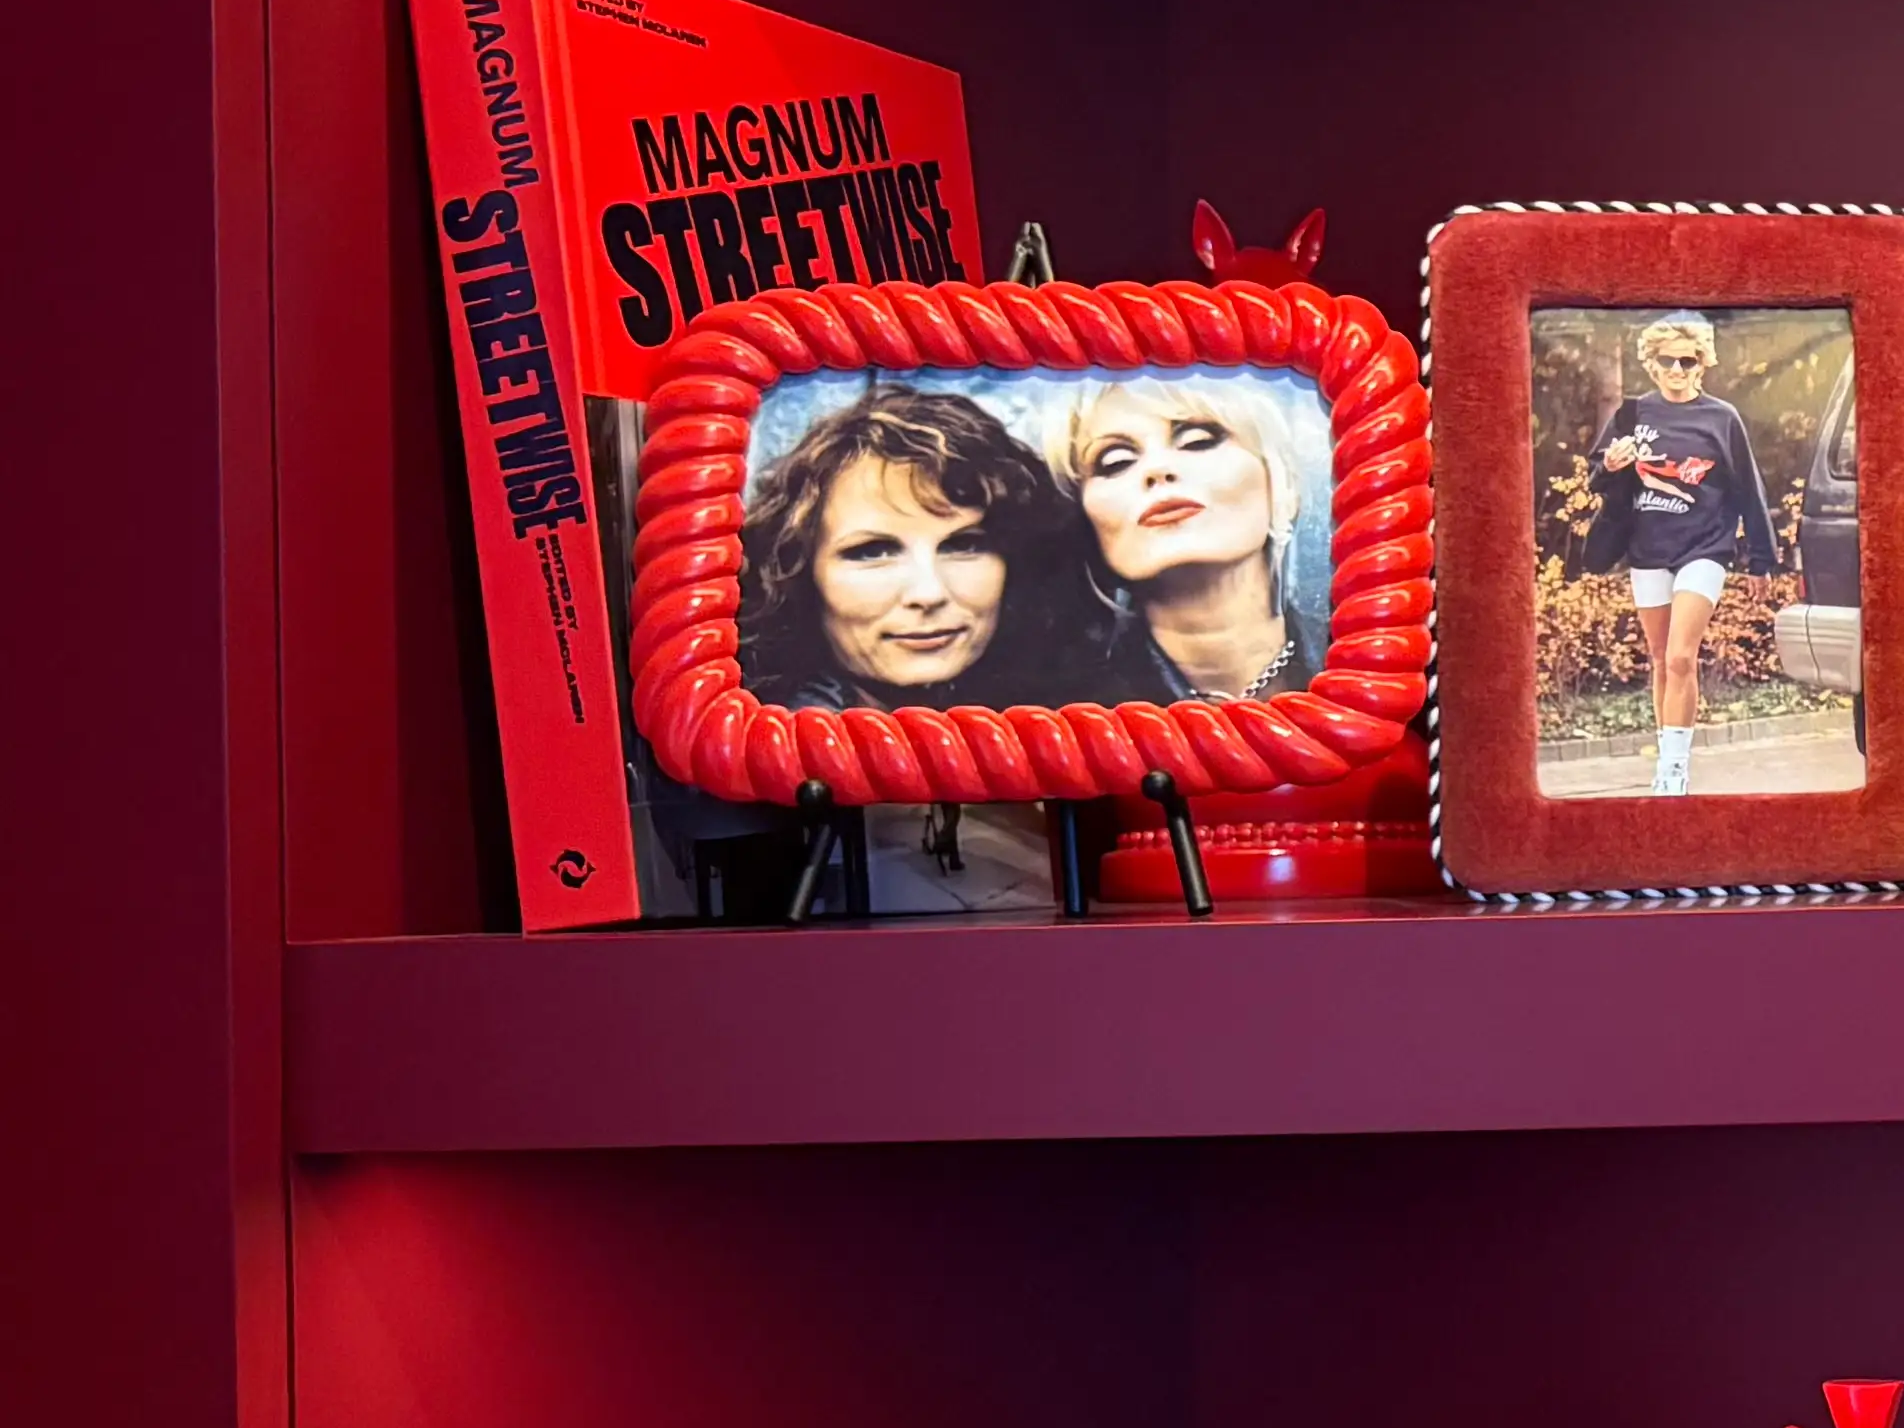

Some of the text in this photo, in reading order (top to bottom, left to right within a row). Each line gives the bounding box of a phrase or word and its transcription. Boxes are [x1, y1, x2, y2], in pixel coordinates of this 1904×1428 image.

[631, 93, 892, 195] MAGNUM
[601, 159, 968, 348] STREETWISE
[442, 189, 587, 540] STREETWISE
